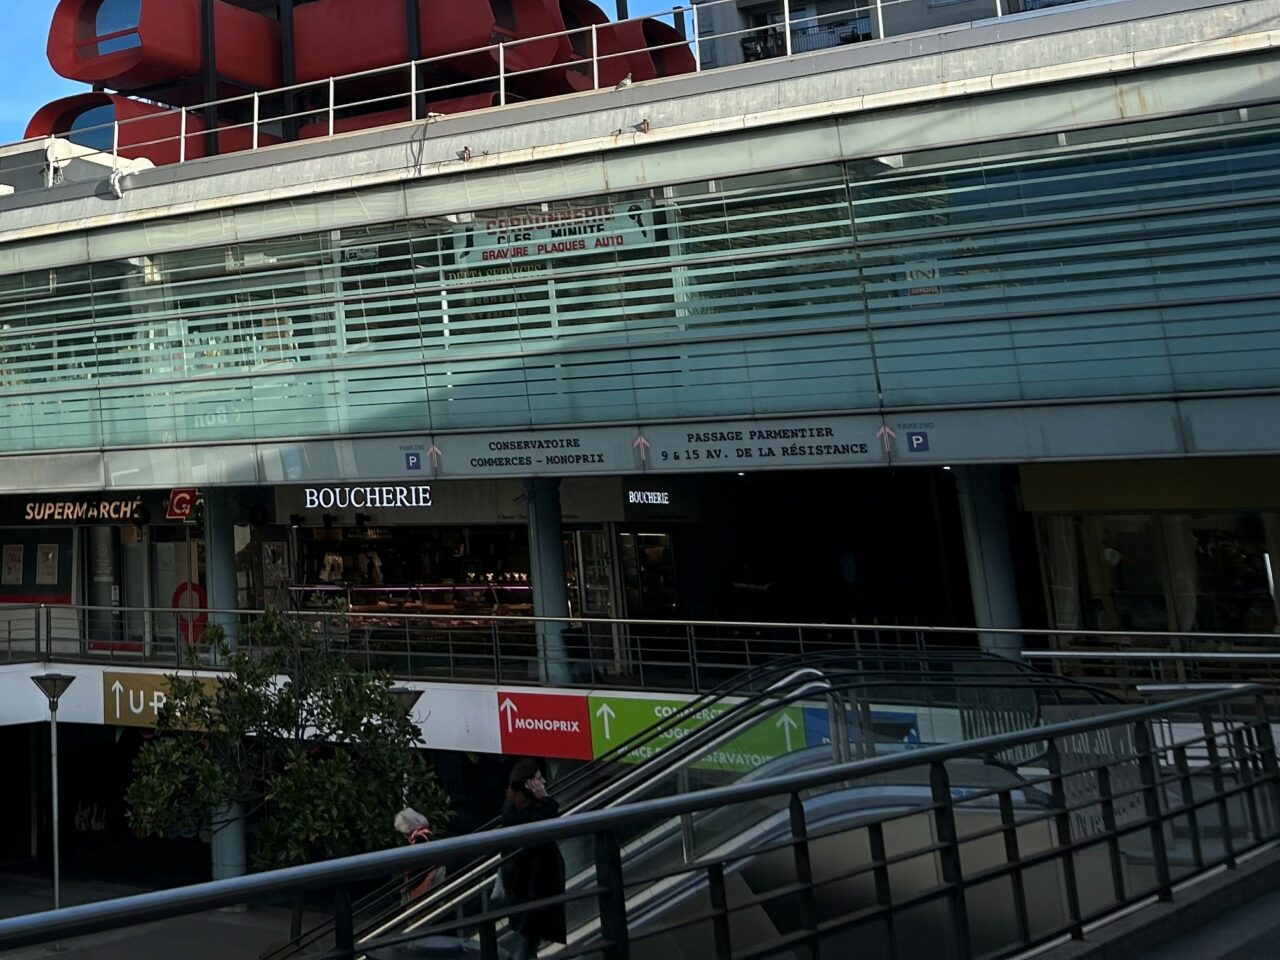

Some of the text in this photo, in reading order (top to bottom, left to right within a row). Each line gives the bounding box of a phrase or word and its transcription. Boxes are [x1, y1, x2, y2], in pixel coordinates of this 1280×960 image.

[482, 235, 624, 261] GRAVURE PLAQUES AUTO
[687, 428, 834, 444] PASSAGE PARMENTIER
[911, 435, 924, 449] P
[488, 438, 581, 451] CONSERVATOIRE
[661, 442, 868, 462] 9 & 15 AV. DE LA RÉSISTANCE
[408, 455, 418, 467] P
[470, 456, 533, 468] COMMERCES
[545, 453, 605, 466] MONOPRIX
[304, 485, 432, 509] BOUCHERIE
[628, 490, 670, 505] BOUCHERIE
[515, 717, 580, 733] MONOPRIX
